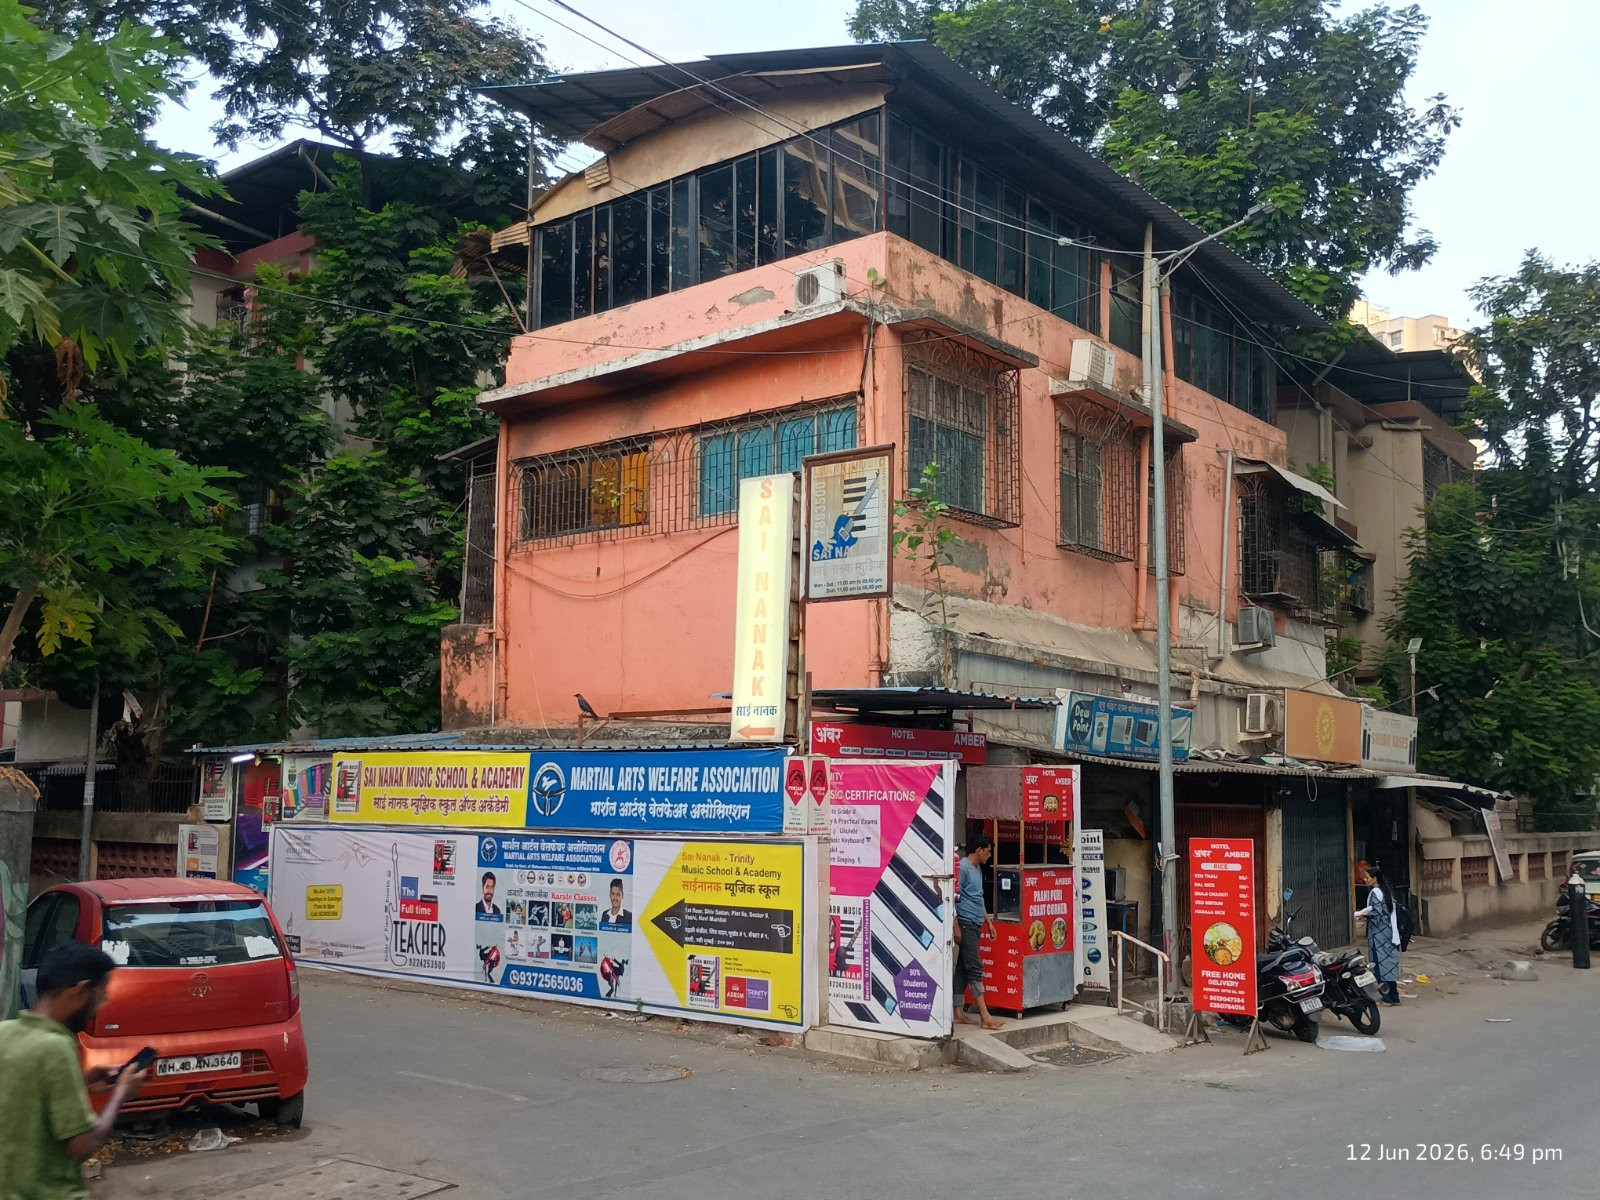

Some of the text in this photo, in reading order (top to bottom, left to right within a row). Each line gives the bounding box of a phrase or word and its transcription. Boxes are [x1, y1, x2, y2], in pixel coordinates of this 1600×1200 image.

[751, 479, 773, 697] SAI NANAK
[736, 703, 778, 716] साई नानक
[1074, 705, 1090, 718] Dew
[1072, 720, 1089, 733] Point
[891, 729, 986, 746] HOTEL AMBER
[364, 766, 526, 790] SAI NANAK MUSIC SCHOOL & ACADEMY
[570, 766, 615, 792] MARTIAL
[616, 766, 646, 792] ARTS
[648, 766, 698, 793] WELFARE
[700, 766, 780, 794] ASSOCIATION
[1055, 778, 1072, 786] AMBER
[374, 793, 387, 809] साई
[388, 796, 410, 810] नानक
[830, 790, 844, 800] SIC
[845, 790, 916, 802] CERTIFICATIONS
[590, 797, 617, 818] मार्शल
[648, 798, 689, 819] वेलफेअर
[690, 798, 752, 824] असोसिएशन
[1081, 835, 1100, 844] oint
[504, 852, 602, 864] MARTIAL ARTS WELFARE ASSOCIATION
[682, 852, 755, 866] Sai Nanak Trinity
[836, 856, 856, 864] Singing
[682, 864, 782, 880] Music School & Academy
[402, 886, 416, 896] The
[682, 878, 780, 899] साईनानक म्यूजिक स्कूल
[551, 892, 597, 902] Karate Classes
[1034, 890, 1063, 902] PAANI PURI
[401, 904, 432, 916] Full time
[843, 906, 862, 916] MUSIC
[1029, 903, 1068, 917] CHAAT CORNER
[393, 920, 447, 957] TEACHER
[408, 958, 446, 970] 9224253500
[836, 970, 861, 979] NANAK
[909, 968, 920, 976] 90%
[1084, 966, 1092, 975] G
[1201, 970, 1246, 980] FREE HOME
[520, 972, 584, 993] 9372565036
[903, 980, 928, 988] Students
[1208, 979, 1239, 987] DELIVERY
[747, 988, 768, 997] TRINITY
[904, 990, 927, 998] Secured
[900, 1001, 931, 1010] Distinction!
